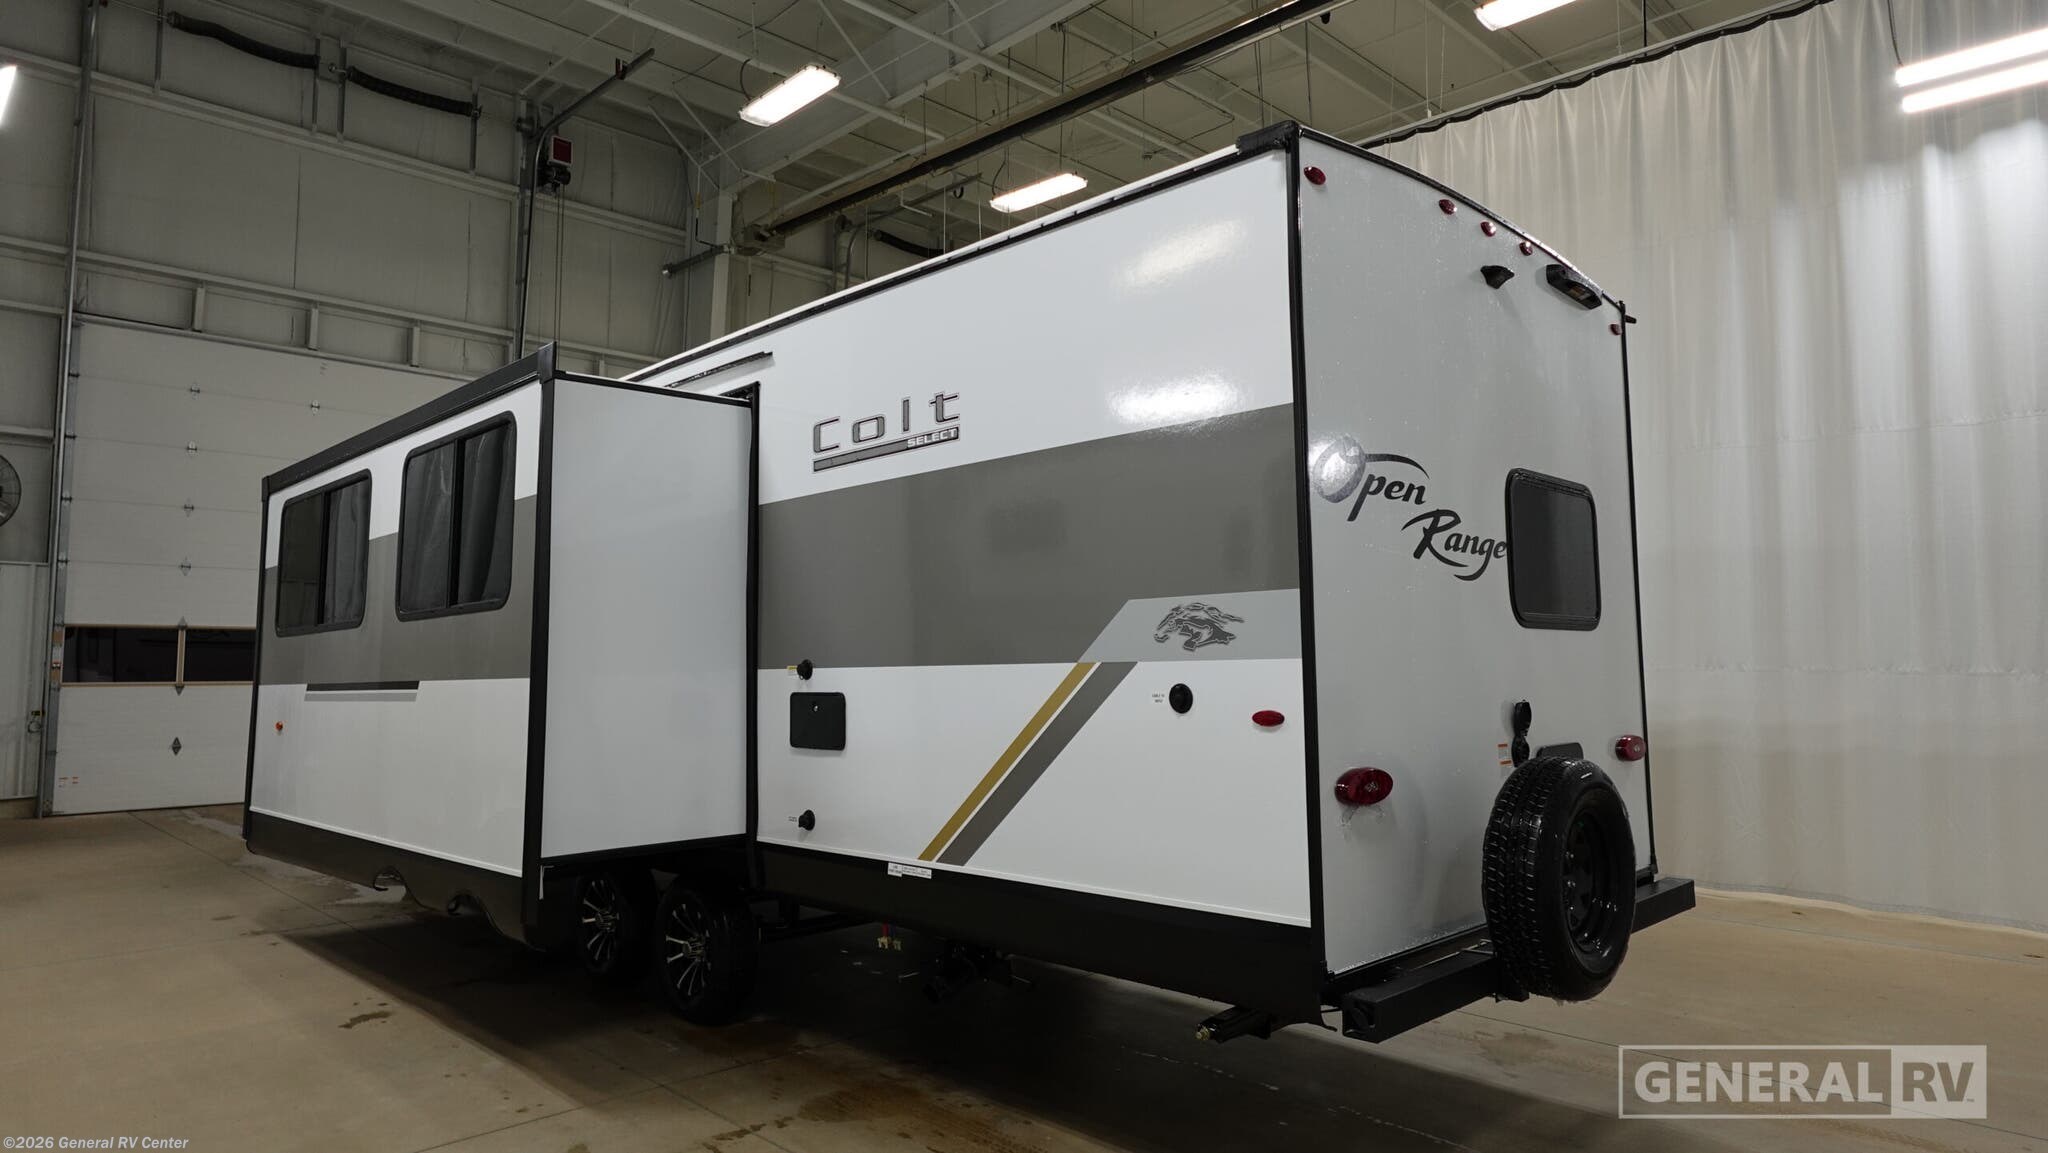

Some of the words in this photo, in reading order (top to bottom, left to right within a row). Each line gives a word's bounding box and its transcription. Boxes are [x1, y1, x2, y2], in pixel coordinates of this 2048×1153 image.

[813, 392, 960, 453] Colt
[907, 428, 957, 448] SELECT
[1312, 434, 1430, 522] Open
[1400, 508, 1507, 581] Range
